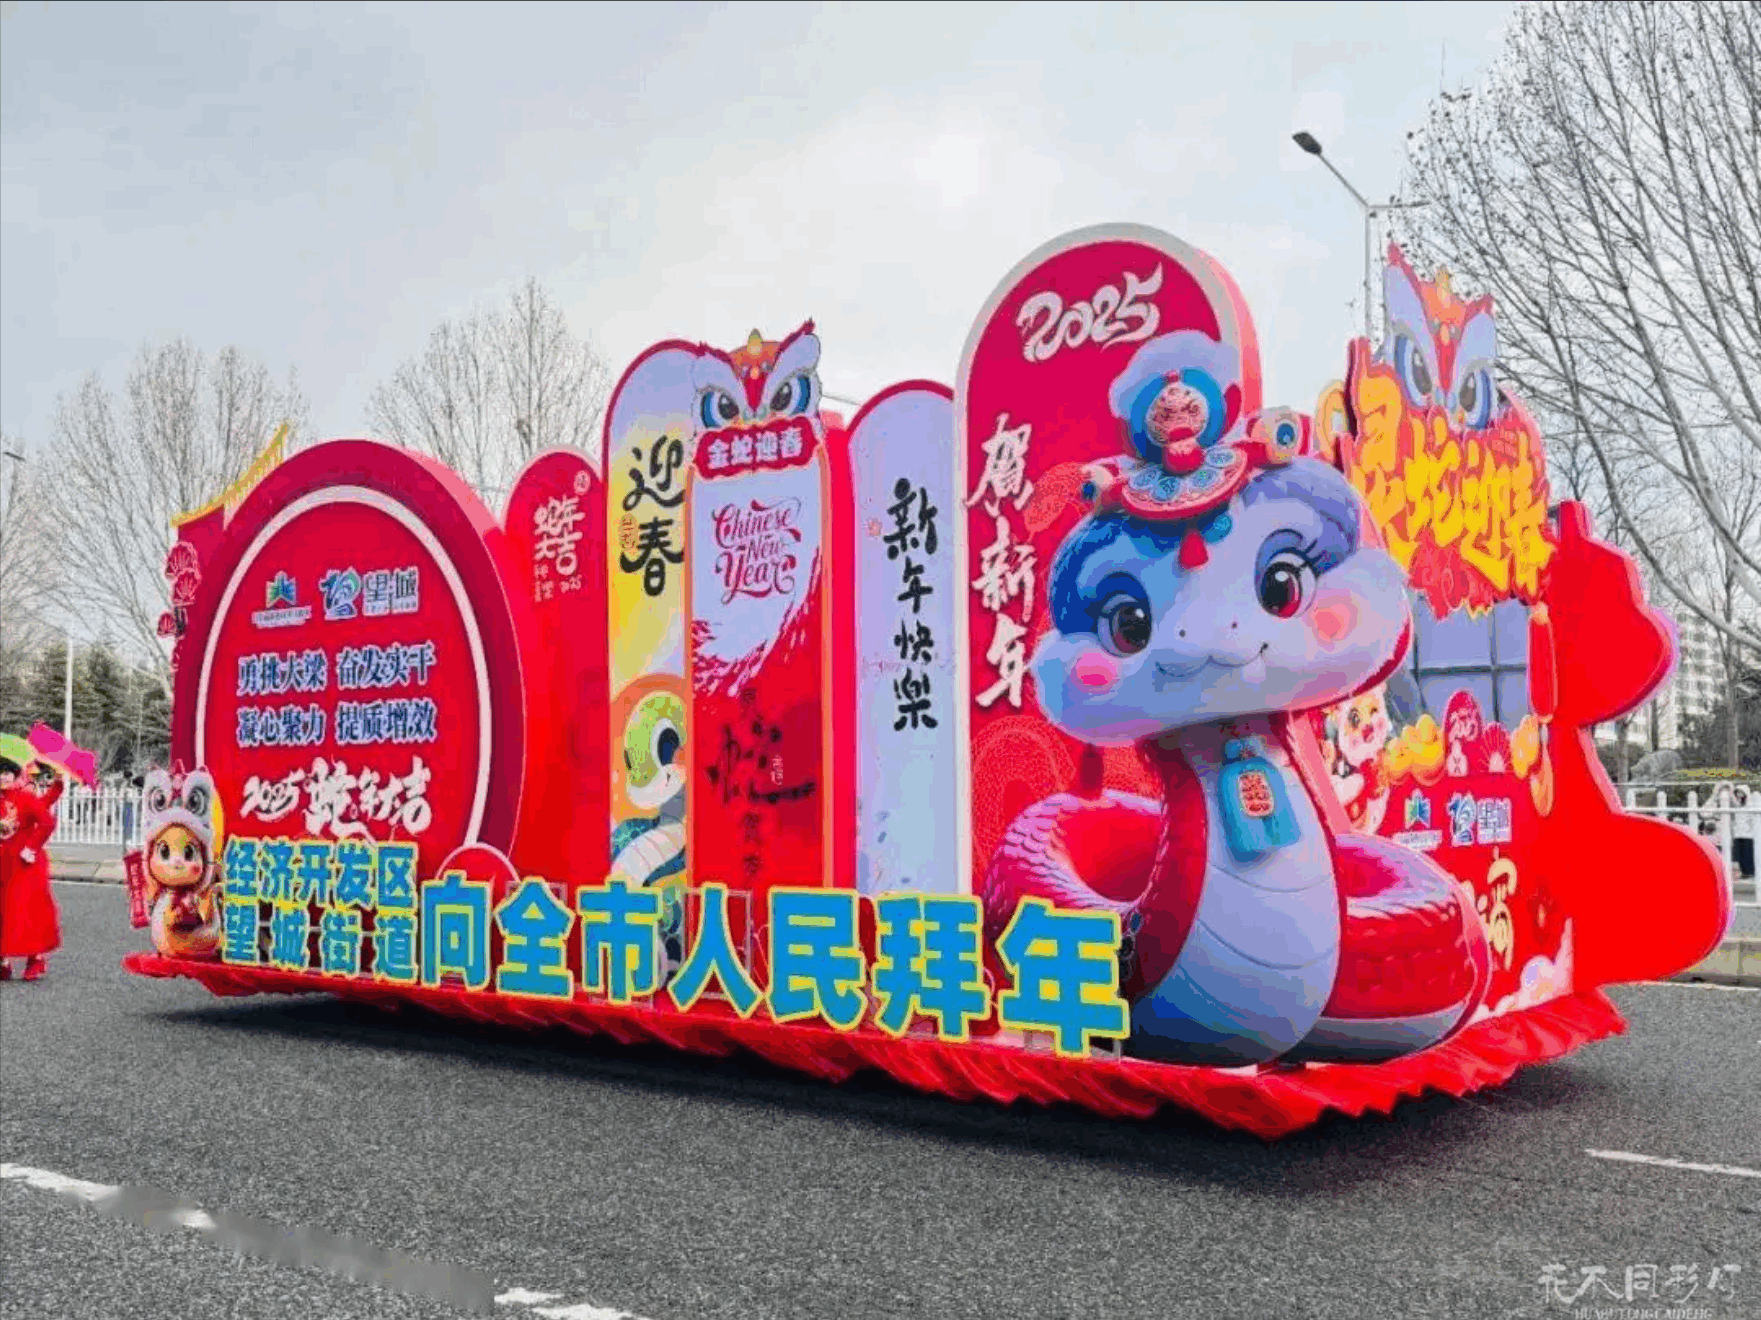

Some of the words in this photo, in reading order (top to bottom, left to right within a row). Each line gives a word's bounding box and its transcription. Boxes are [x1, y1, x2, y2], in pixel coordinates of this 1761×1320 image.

[1016, 263, 1162, 362] 2025
[707, 428, 803, 469] 金蛇迎春
[619, 435, 686, 597] 迎春
[711, 500, 801, 550] Chinese
[746, 537, 782, 563] New
[715, 552, 797, 605] Year
[237, 649, 328, 696] 勇挑大梁
[337, 641, 436, 690] 奋发实干
[237, 704, 327, 746] 凝心聚力
[336, 699, 437, 744] 提质增效
[225, 835, 418, 908] 经济开发区
[222, 901, 417, 983] 望城街道
[421, 869, 1130, 1057] 向全市人民拜年
